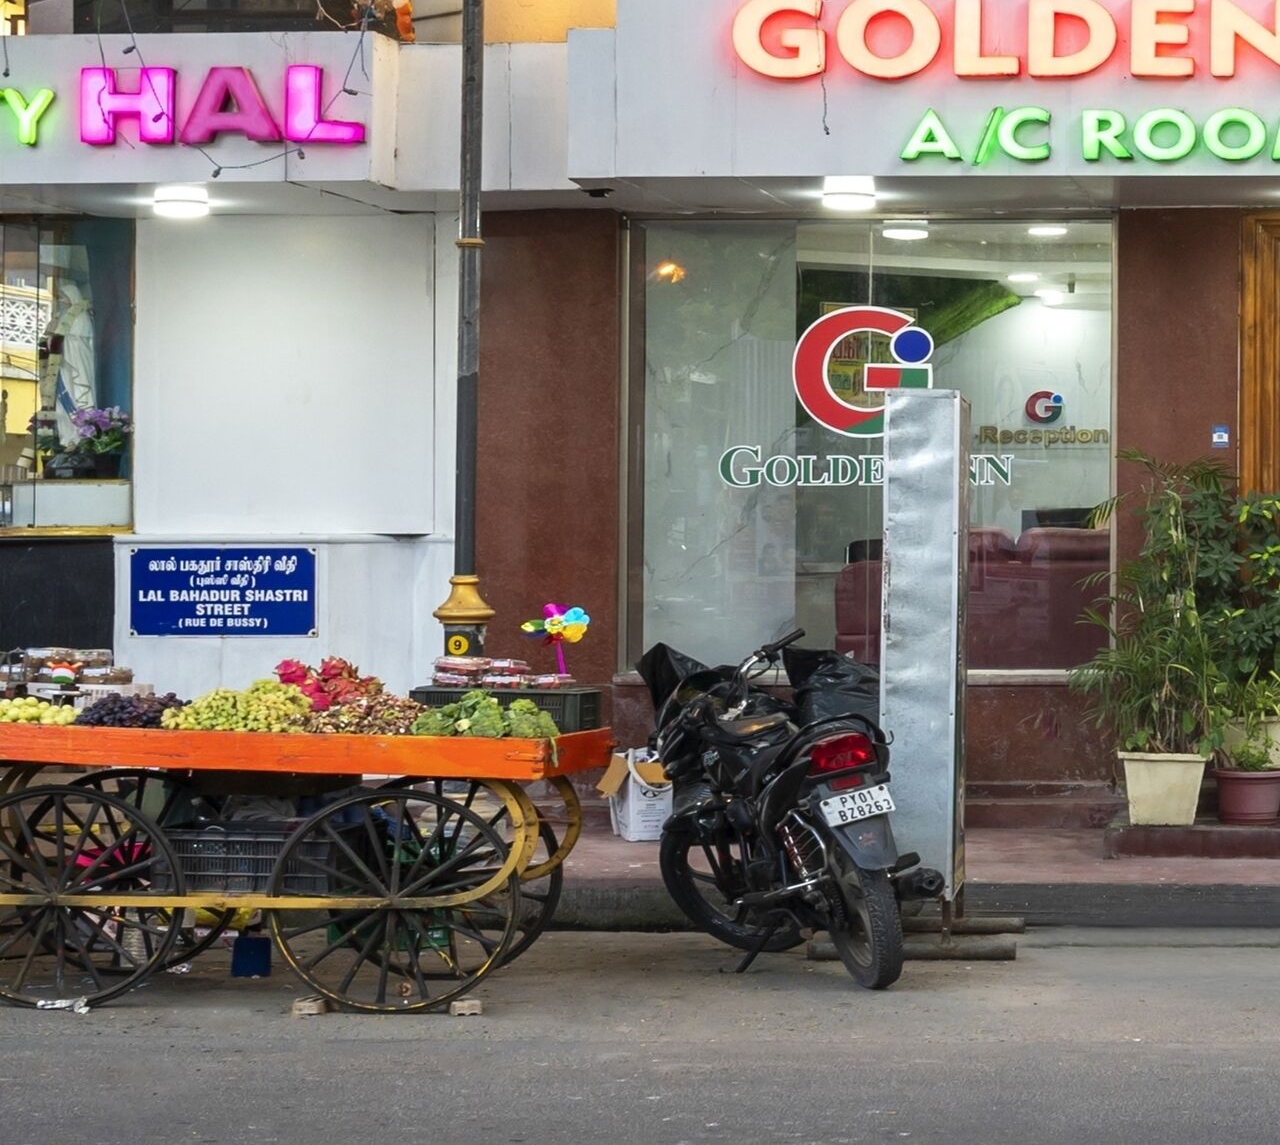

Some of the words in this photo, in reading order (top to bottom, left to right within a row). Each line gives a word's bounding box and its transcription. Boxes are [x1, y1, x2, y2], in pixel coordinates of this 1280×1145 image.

[80, 64, 366, 146] HAL
[900, 106, 1052, 166] A/C
[979, 425, 1109, 447] Reception
[719, 445, 884, 488] GOLDE
[148, 556, 178, 572] லால்
[180, 556, 222, 575] பகதூர்
[274, 556, 298, 575] வீதி
[139, 590, 165, 602] LAL
[170, 590, 240, 602] BAHADUR
[245, 590, 308, 602] SHASTRI
[196, 604, 251, 616] STREET
[210, 618, 224, 627] DE
[453, 639, 462, 651] 9
[840, 790, 875, 808] PY01
